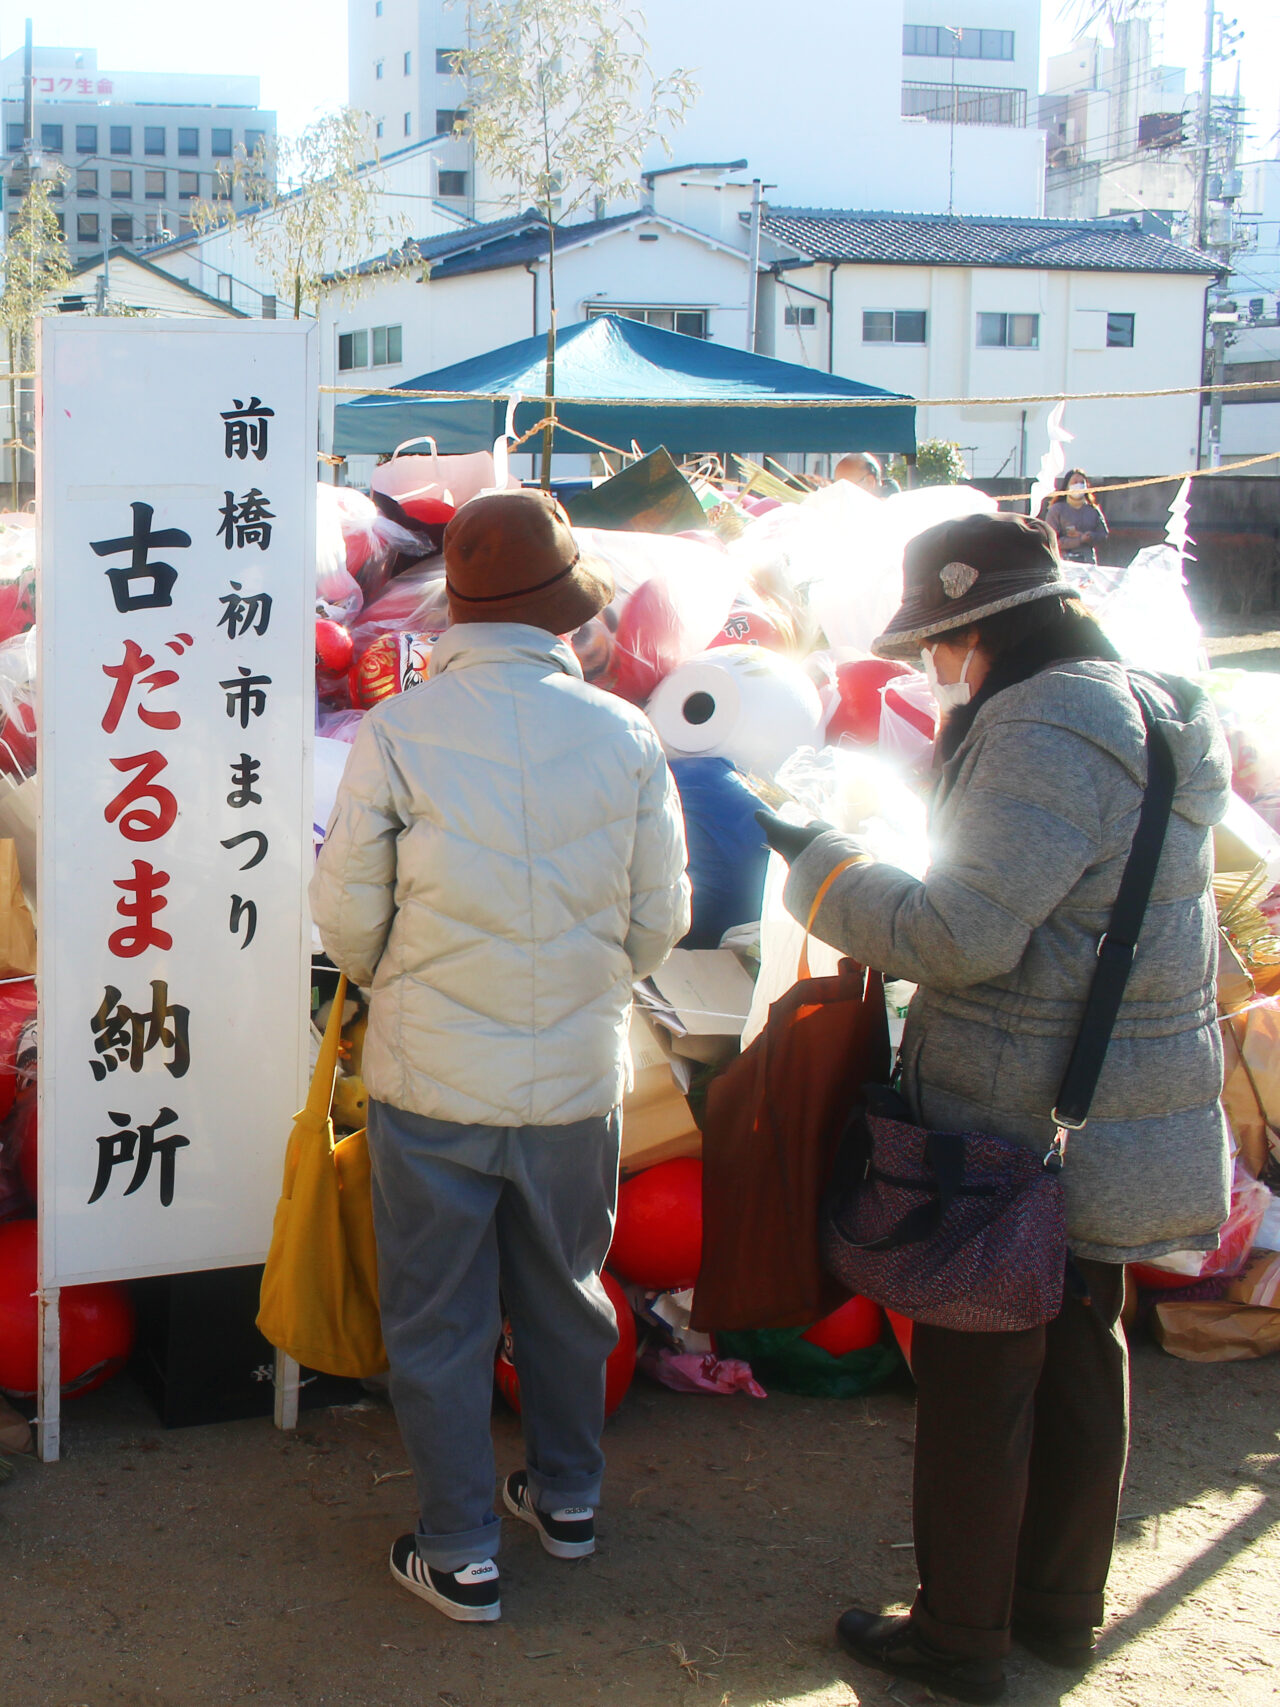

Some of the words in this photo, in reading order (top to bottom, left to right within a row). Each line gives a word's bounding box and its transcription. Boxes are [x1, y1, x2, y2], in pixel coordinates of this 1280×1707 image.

[32, 77, 113, 94] コク生命
[216, 396, 276, 950] 前橋初市まつり
[87, 501, 194, 1207] 古だるま納所
[470, 1565, 494, 1576] adidas
